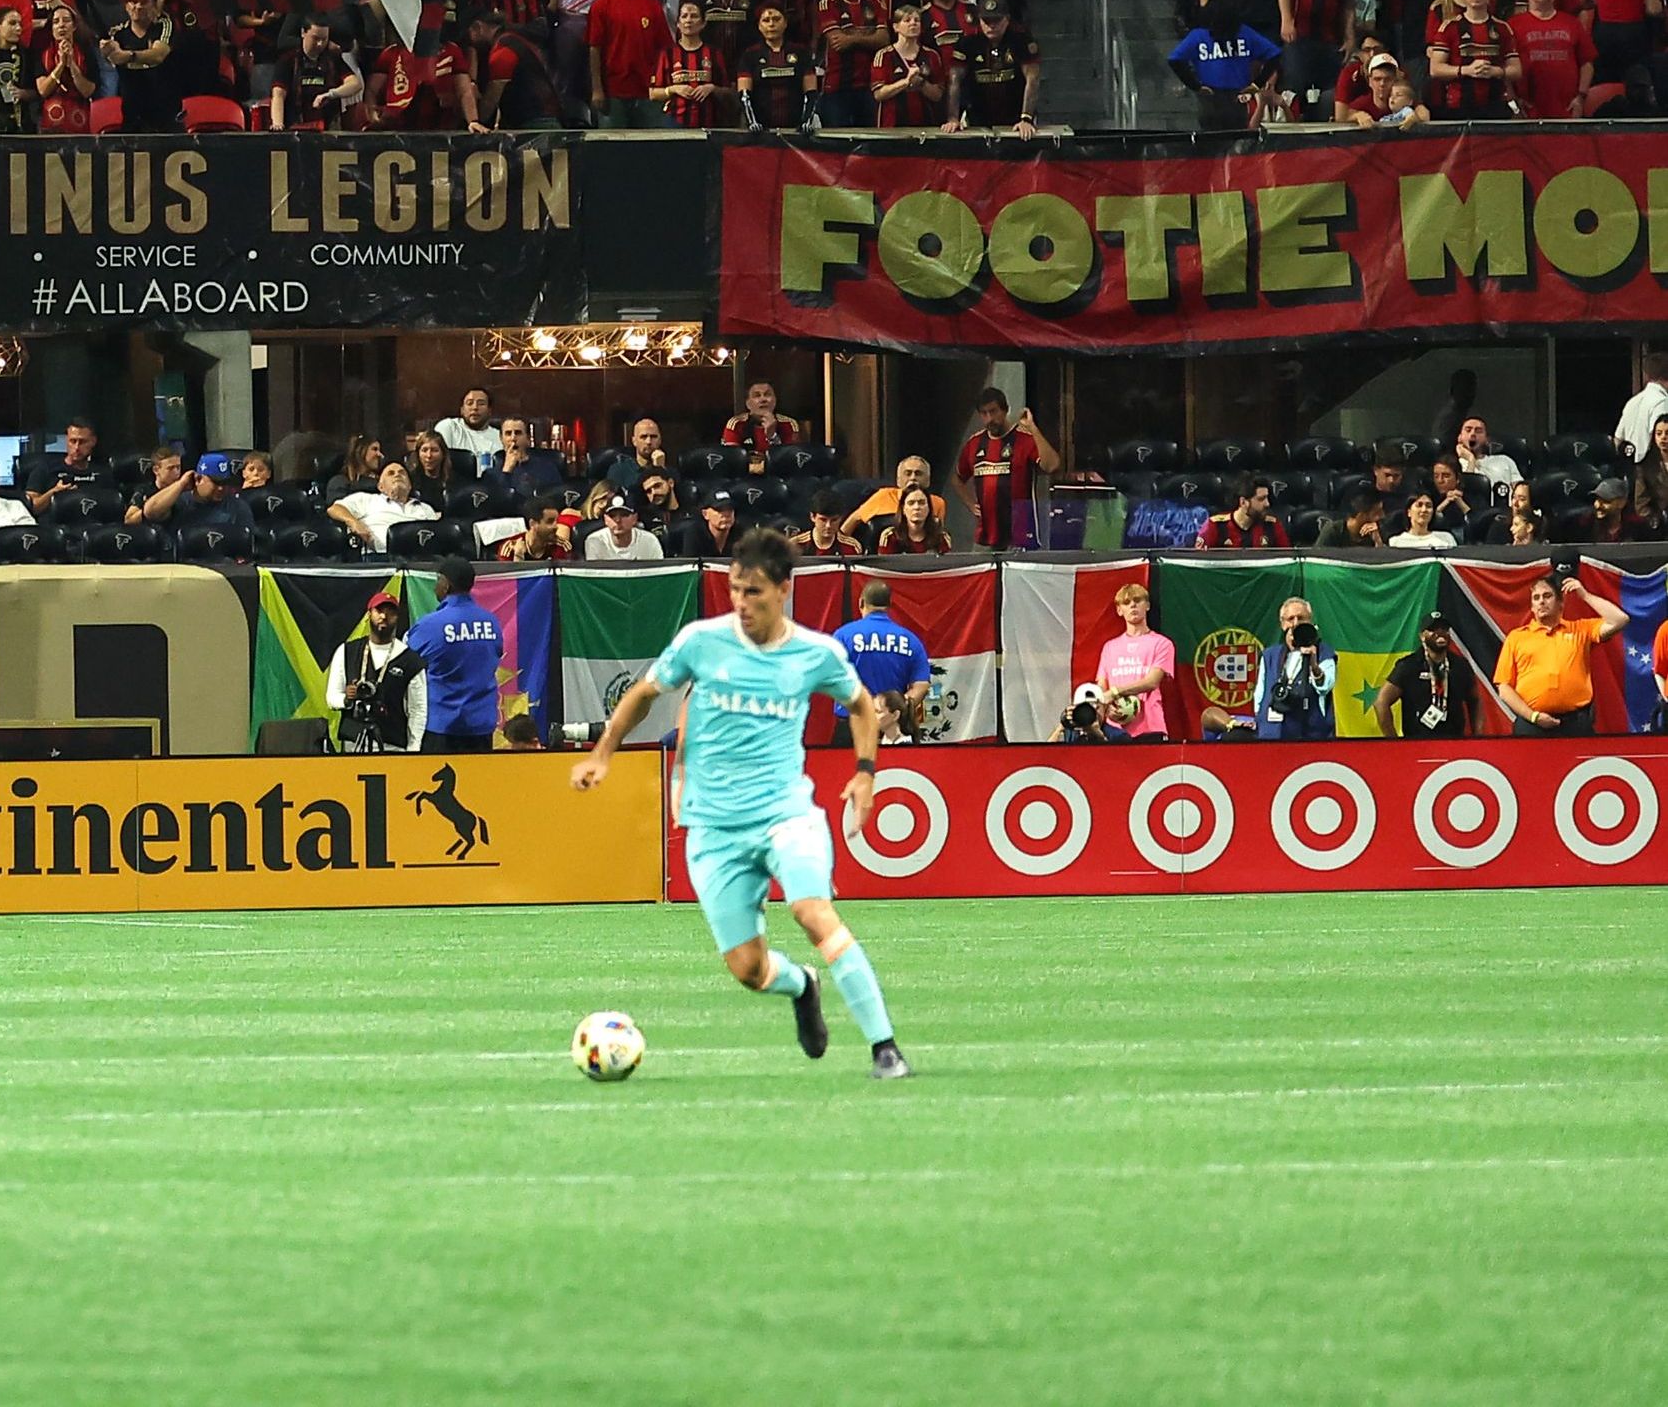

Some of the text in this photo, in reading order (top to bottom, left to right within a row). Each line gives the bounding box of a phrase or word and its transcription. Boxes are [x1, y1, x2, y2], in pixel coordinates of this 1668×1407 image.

[270, 149, 571, 233] LEGION
[95, 245, 197, 267] SERVICE
[310, 244, 464, 267] COMMUNITY
[780, 180, 1355, 304] FOOTIE
[31, 278, 310, 315] #ALLABOARD
[444, 621, 497, 643] S.A.F.E.
[852, 632, 913, 657] S.A.F.E.
[708, 692, 799, 720] MIAMI
